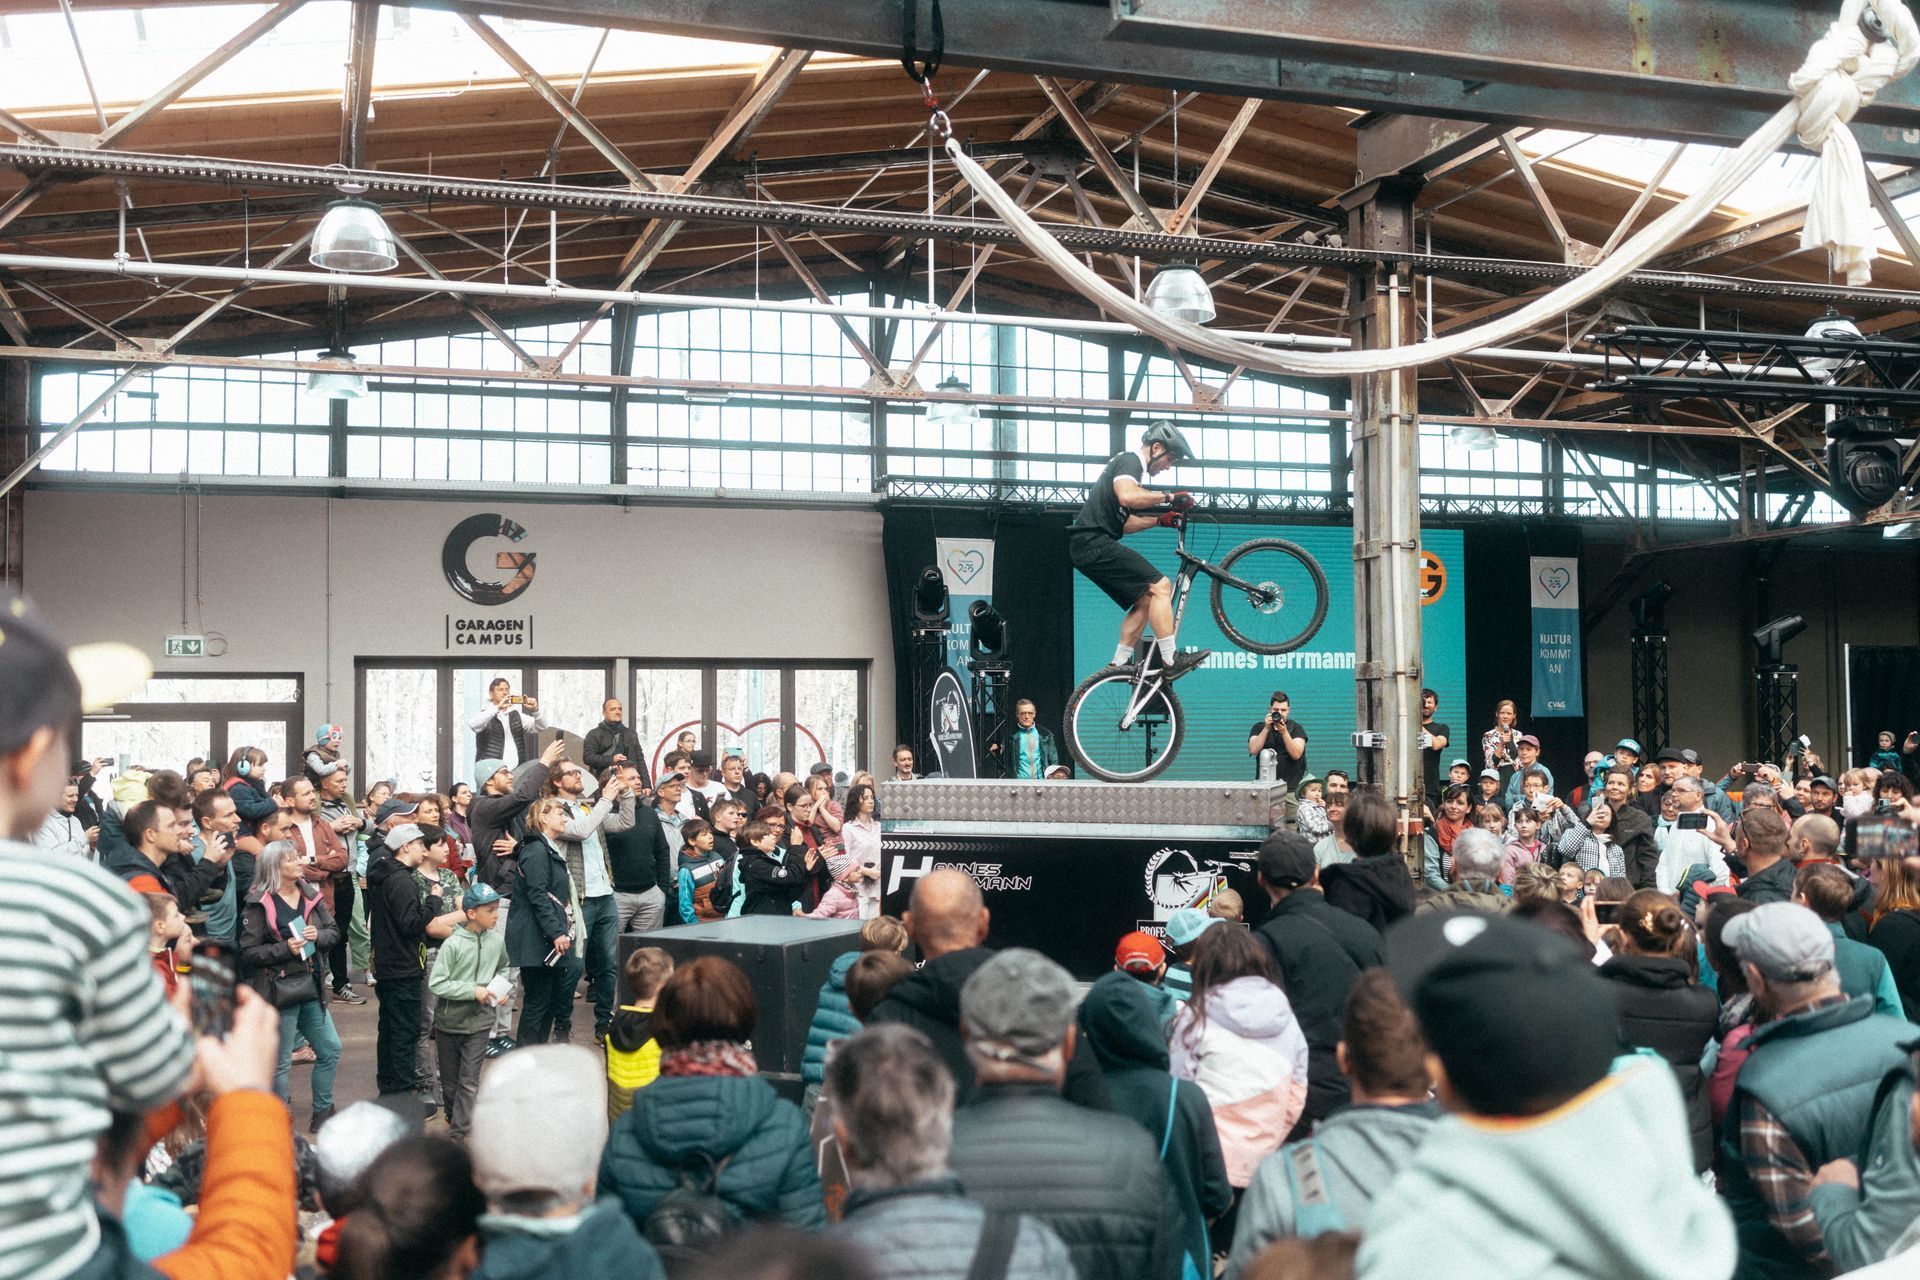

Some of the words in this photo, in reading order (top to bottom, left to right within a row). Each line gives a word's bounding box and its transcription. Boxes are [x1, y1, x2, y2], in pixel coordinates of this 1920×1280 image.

[455, 619, 524, 631] GARAGEN
[455, 633, 523, 645] CAMPUS
[1540, 634, 1572, 645] KULTUR
[1540, 649, 1571, 659] KOMMT
[1549, 664, 1561, 674] AN
